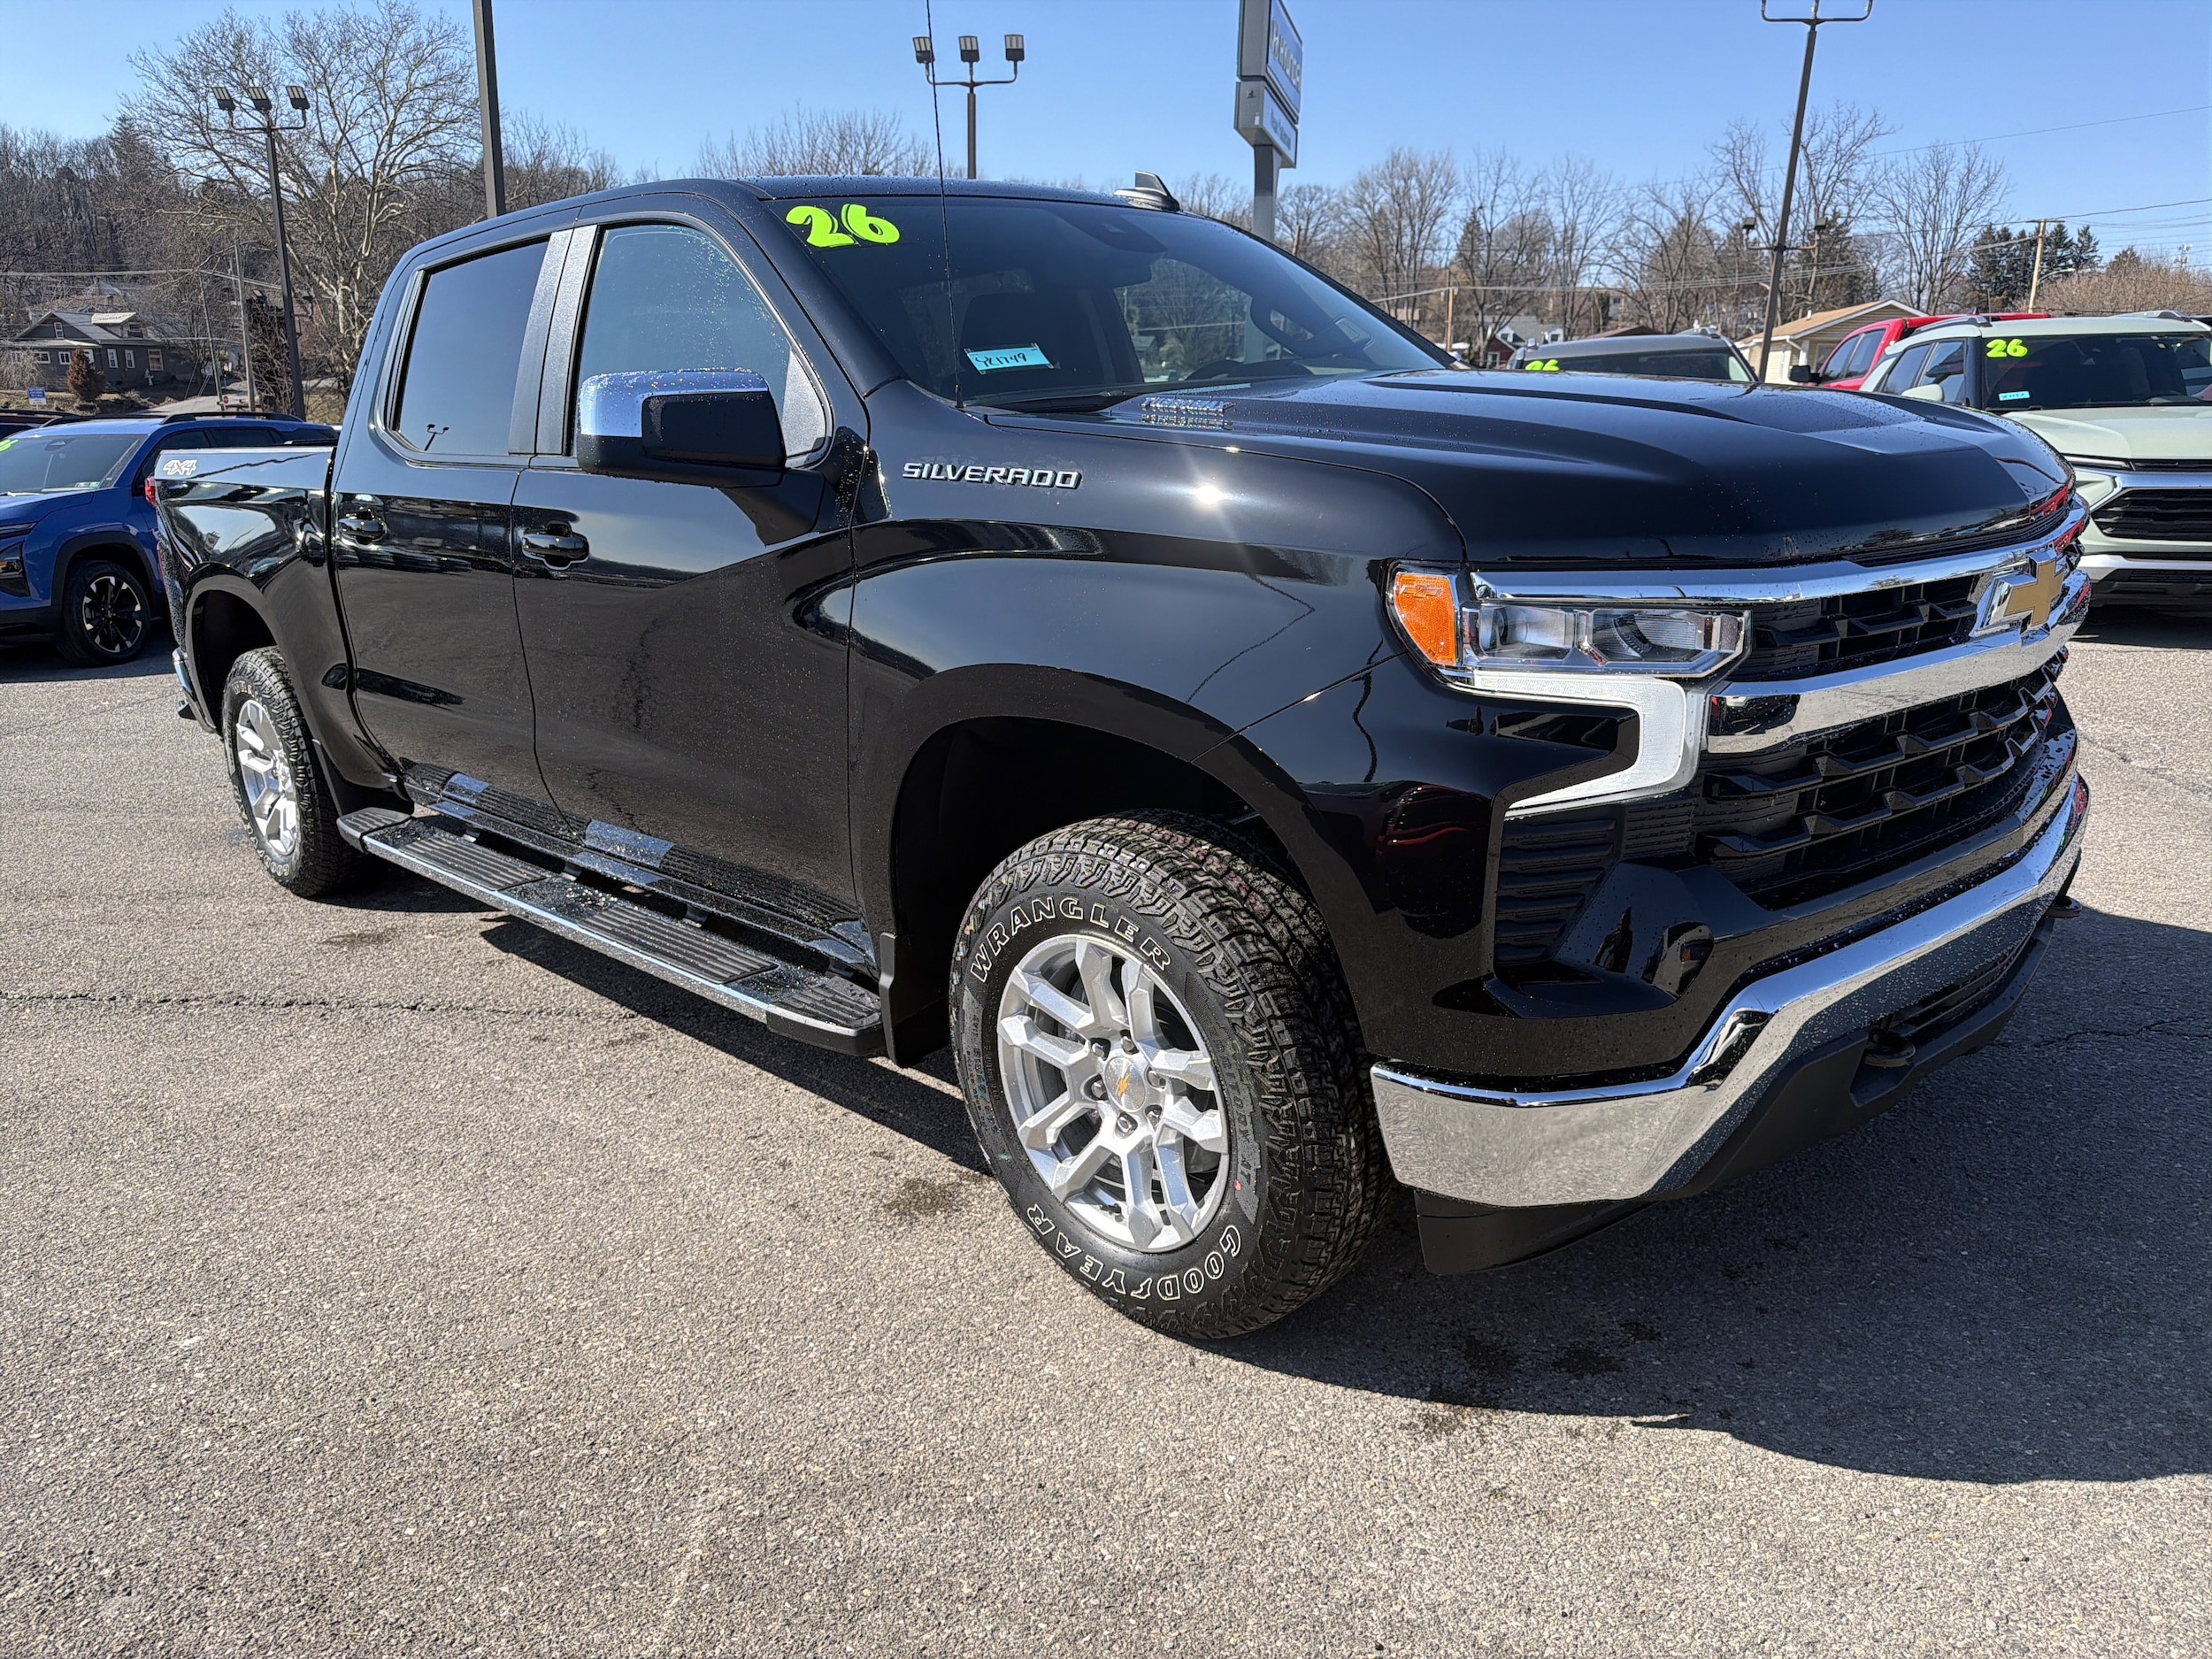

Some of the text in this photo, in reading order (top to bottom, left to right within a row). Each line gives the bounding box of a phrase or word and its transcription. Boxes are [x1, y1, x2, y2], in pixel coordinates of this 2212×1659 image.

[786, 204, 901, 248] 26
[1986, 338, 2028, 358] 26
[902, 462, 1082, 489] SILVERADO
[970, 897, 1171, 983] WRANGLER
[1026, 1204, 1240, 1301] GOODYEAR
